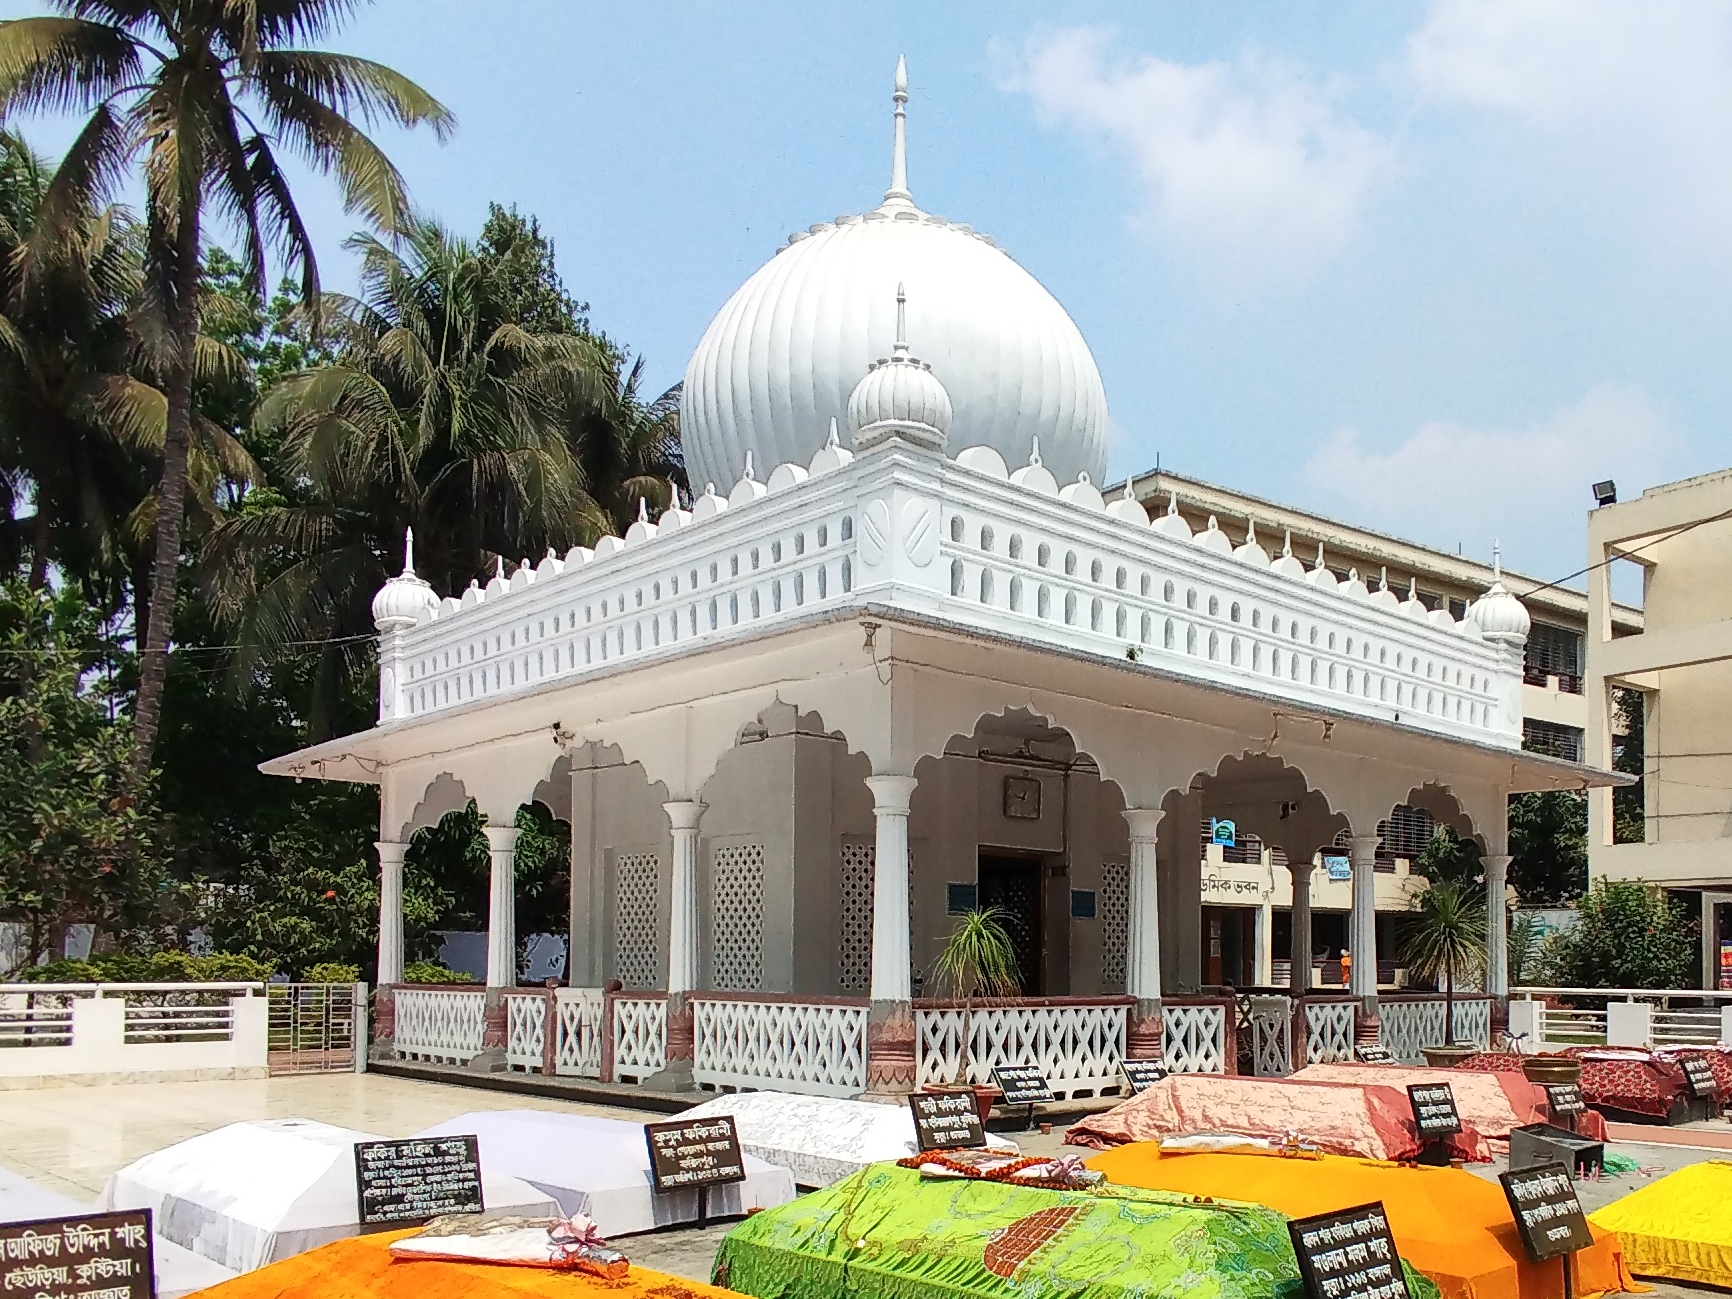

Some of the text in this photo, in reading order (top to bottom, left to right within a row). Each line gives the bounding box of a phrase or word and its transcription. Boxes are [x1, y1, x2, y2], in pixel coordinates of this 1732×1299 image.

[1232, 879, 1259, 894] ভবন
[7, 1229, 62, 1260] আফিজ
[63, 1223, 111, 1254] উদ্দিন
[1311, 1248, 1348, 1274] মওলানা
